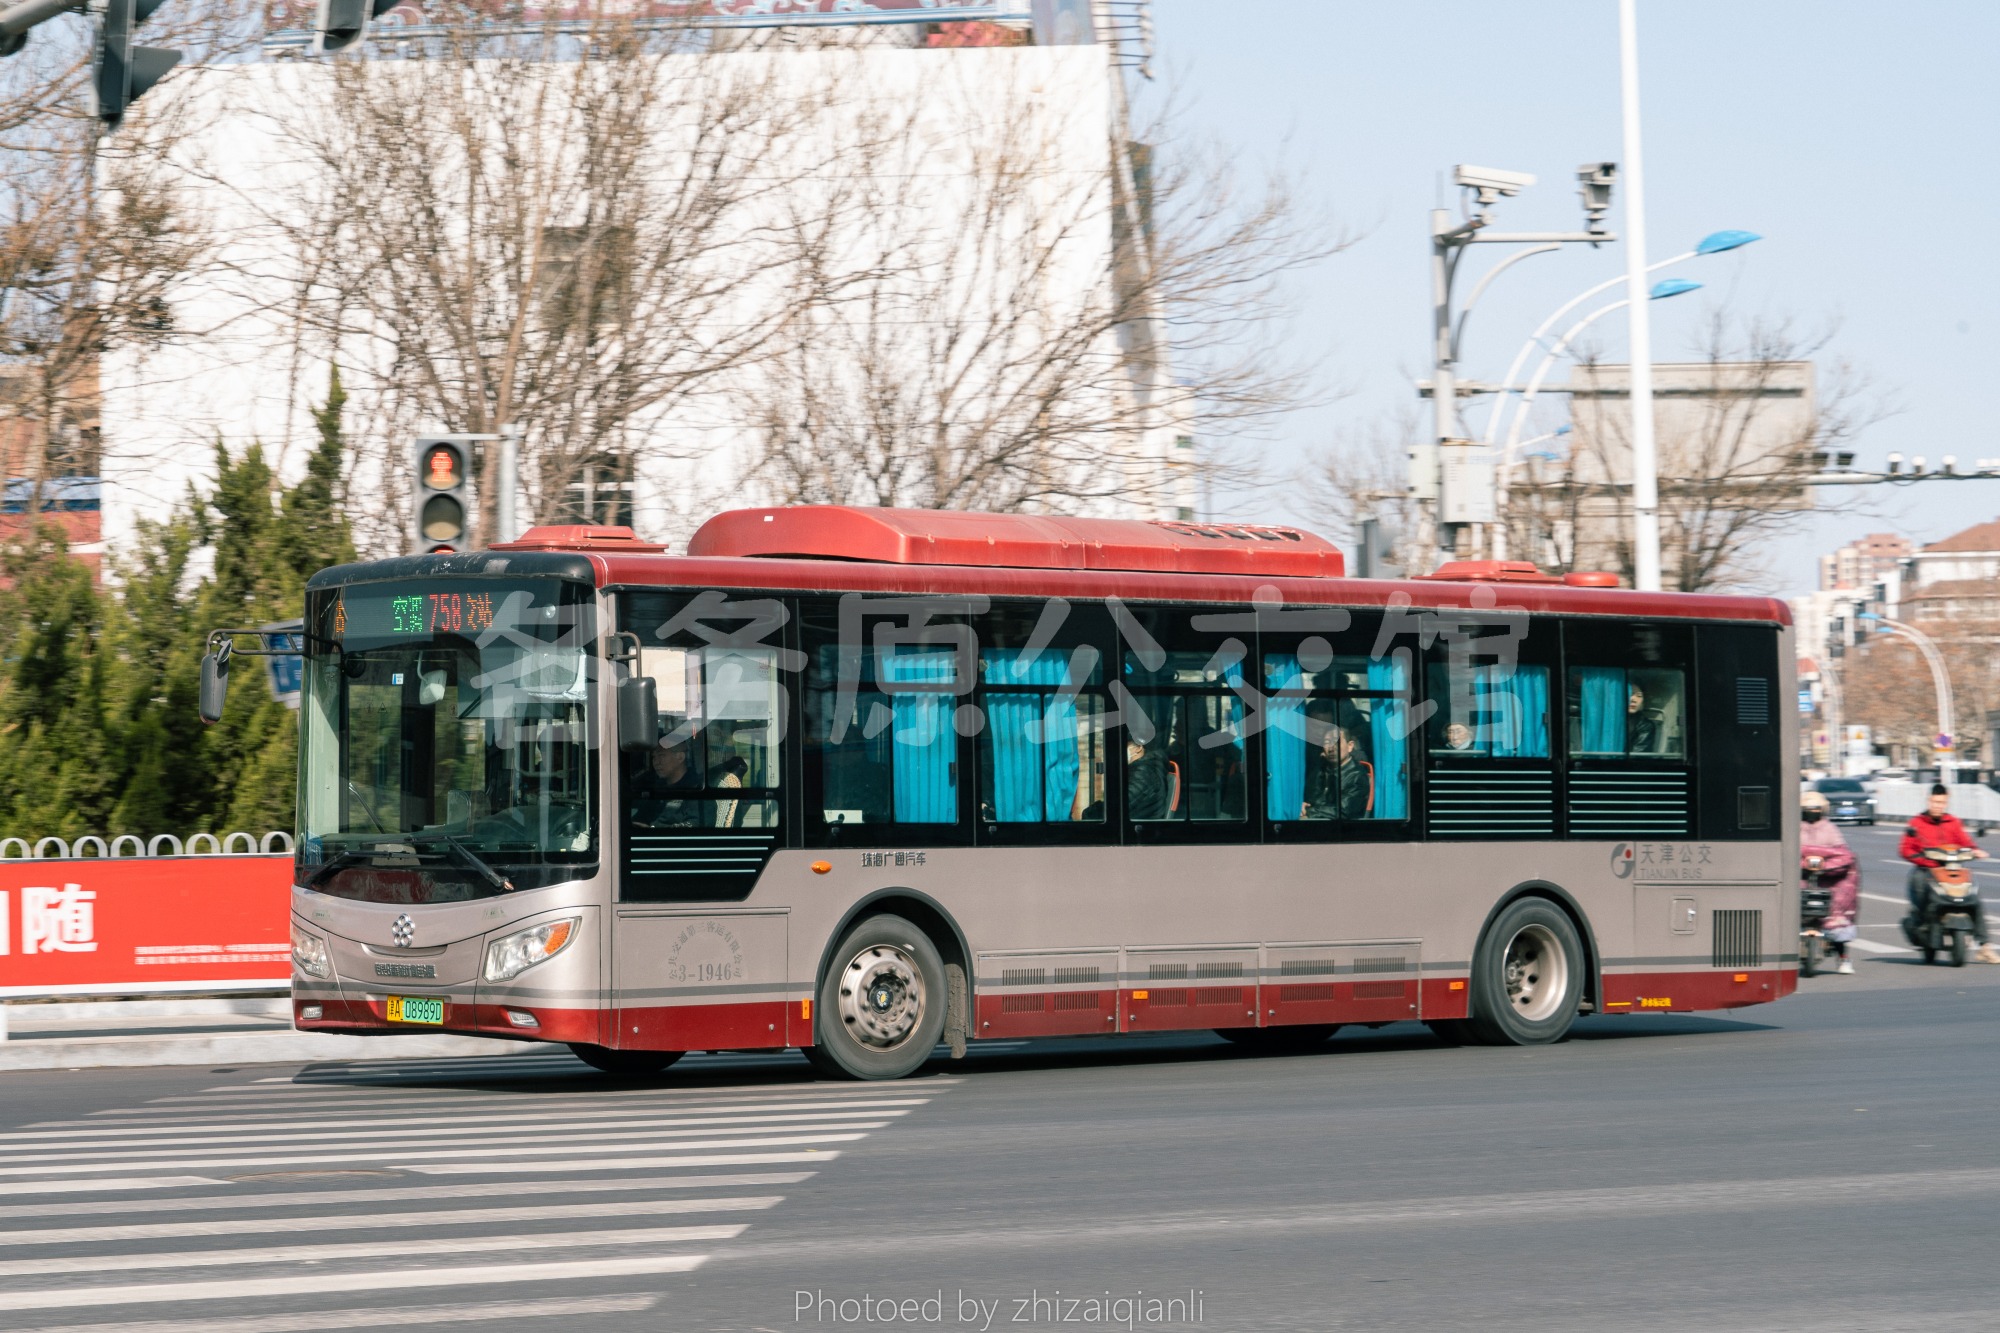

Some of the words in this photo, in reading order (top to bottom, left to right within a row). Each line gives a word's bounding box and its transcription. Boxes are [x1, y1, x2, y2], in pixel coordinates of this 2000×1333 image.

[428, 592, 461, 632] 758
[861, 851, 927, 867] 珠海广通汽车
[1640, 843, 1712, 864] 天津公交
[1640, 867, 1679, 878] TIANJIN
[1681, 867, 1703, 878] BUS
[0, 883, 98, 956] 随
[678, 962, 732, 982] 3-1946
